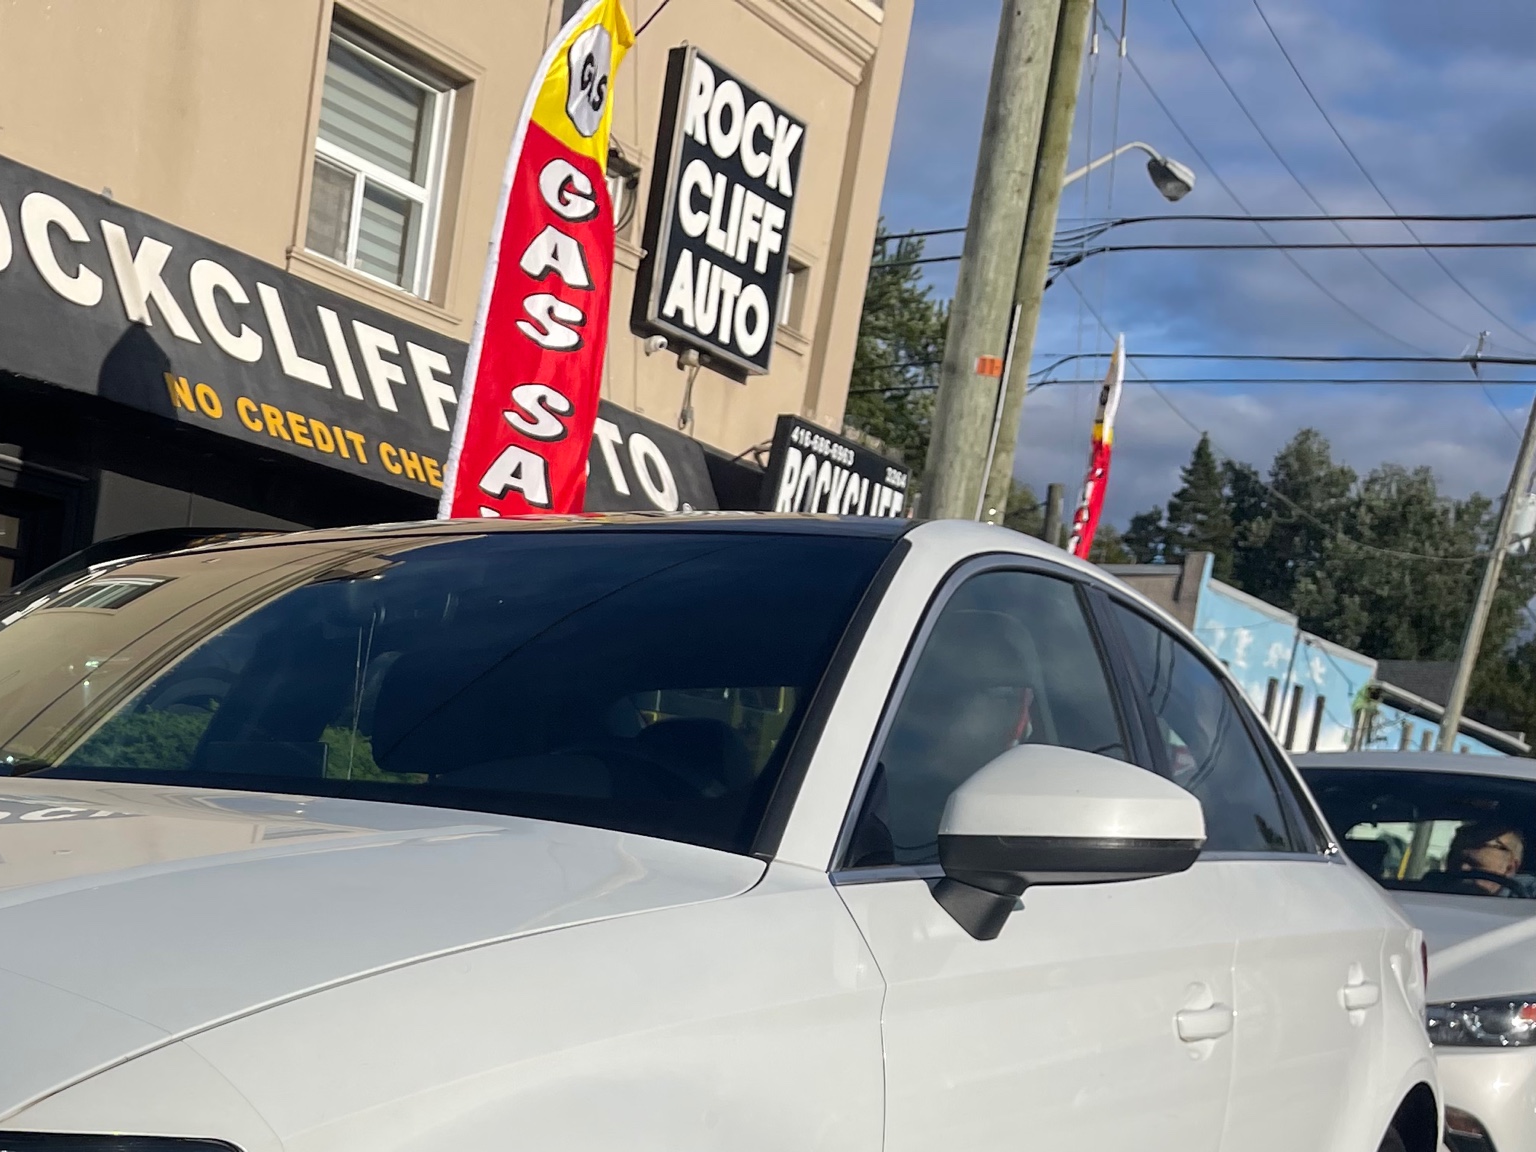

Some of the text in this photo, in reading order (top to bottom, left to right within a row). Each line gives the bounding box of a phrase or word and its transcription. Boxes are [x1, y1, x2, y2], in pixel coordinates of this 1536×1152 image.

[683, 57, 804, 198] ROCK
[516, 157, 601, 352] GAS
[678, 158, 787, 275] CLIFF
[662, 247, 771, 357] AUTO
[164, 372, 224, 420] NO
[236, 396, 368, 464] CREDIT
[585, 416, 679, 512] TO
